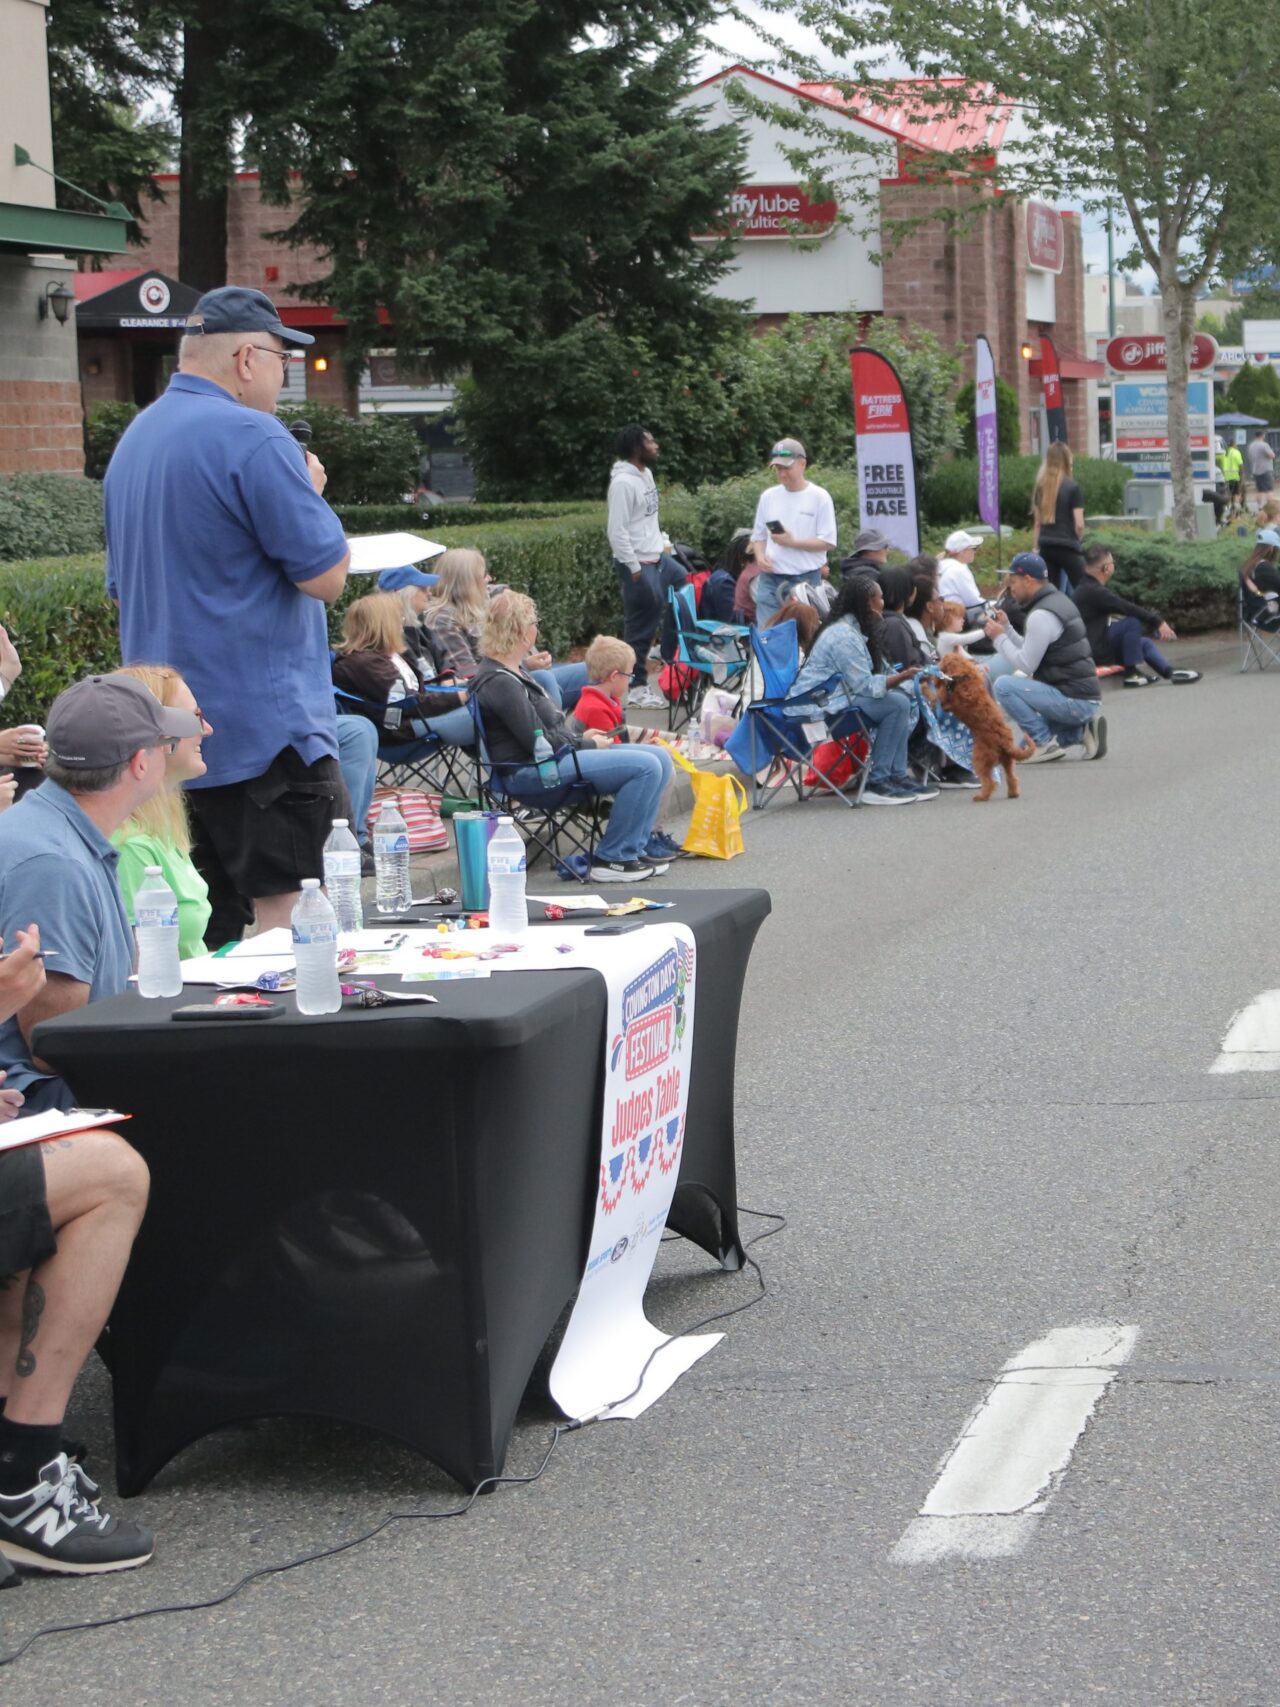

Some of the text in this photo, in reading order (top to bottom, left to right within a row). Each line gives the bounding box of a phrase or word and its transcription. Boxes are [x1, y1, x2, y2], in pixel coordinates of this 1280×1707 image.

[718, 193, 800, 217] iffy lube
[737, 215, 800, 228] multice
[120, 318, 169, 327] CLEARANCE
[1221, 351, 1249, 361] ARCO
[868, 403, 893, 418] FIRM
[864, 464, 904, 482] FREE
[866, 500, 908, 517] BASE
[625, 958, 676, 1023] COVINGTON DAYS
[630, 1017, 668, 1068] FESTIVAL
[612, 1066, 681, 1148] Judges Table
